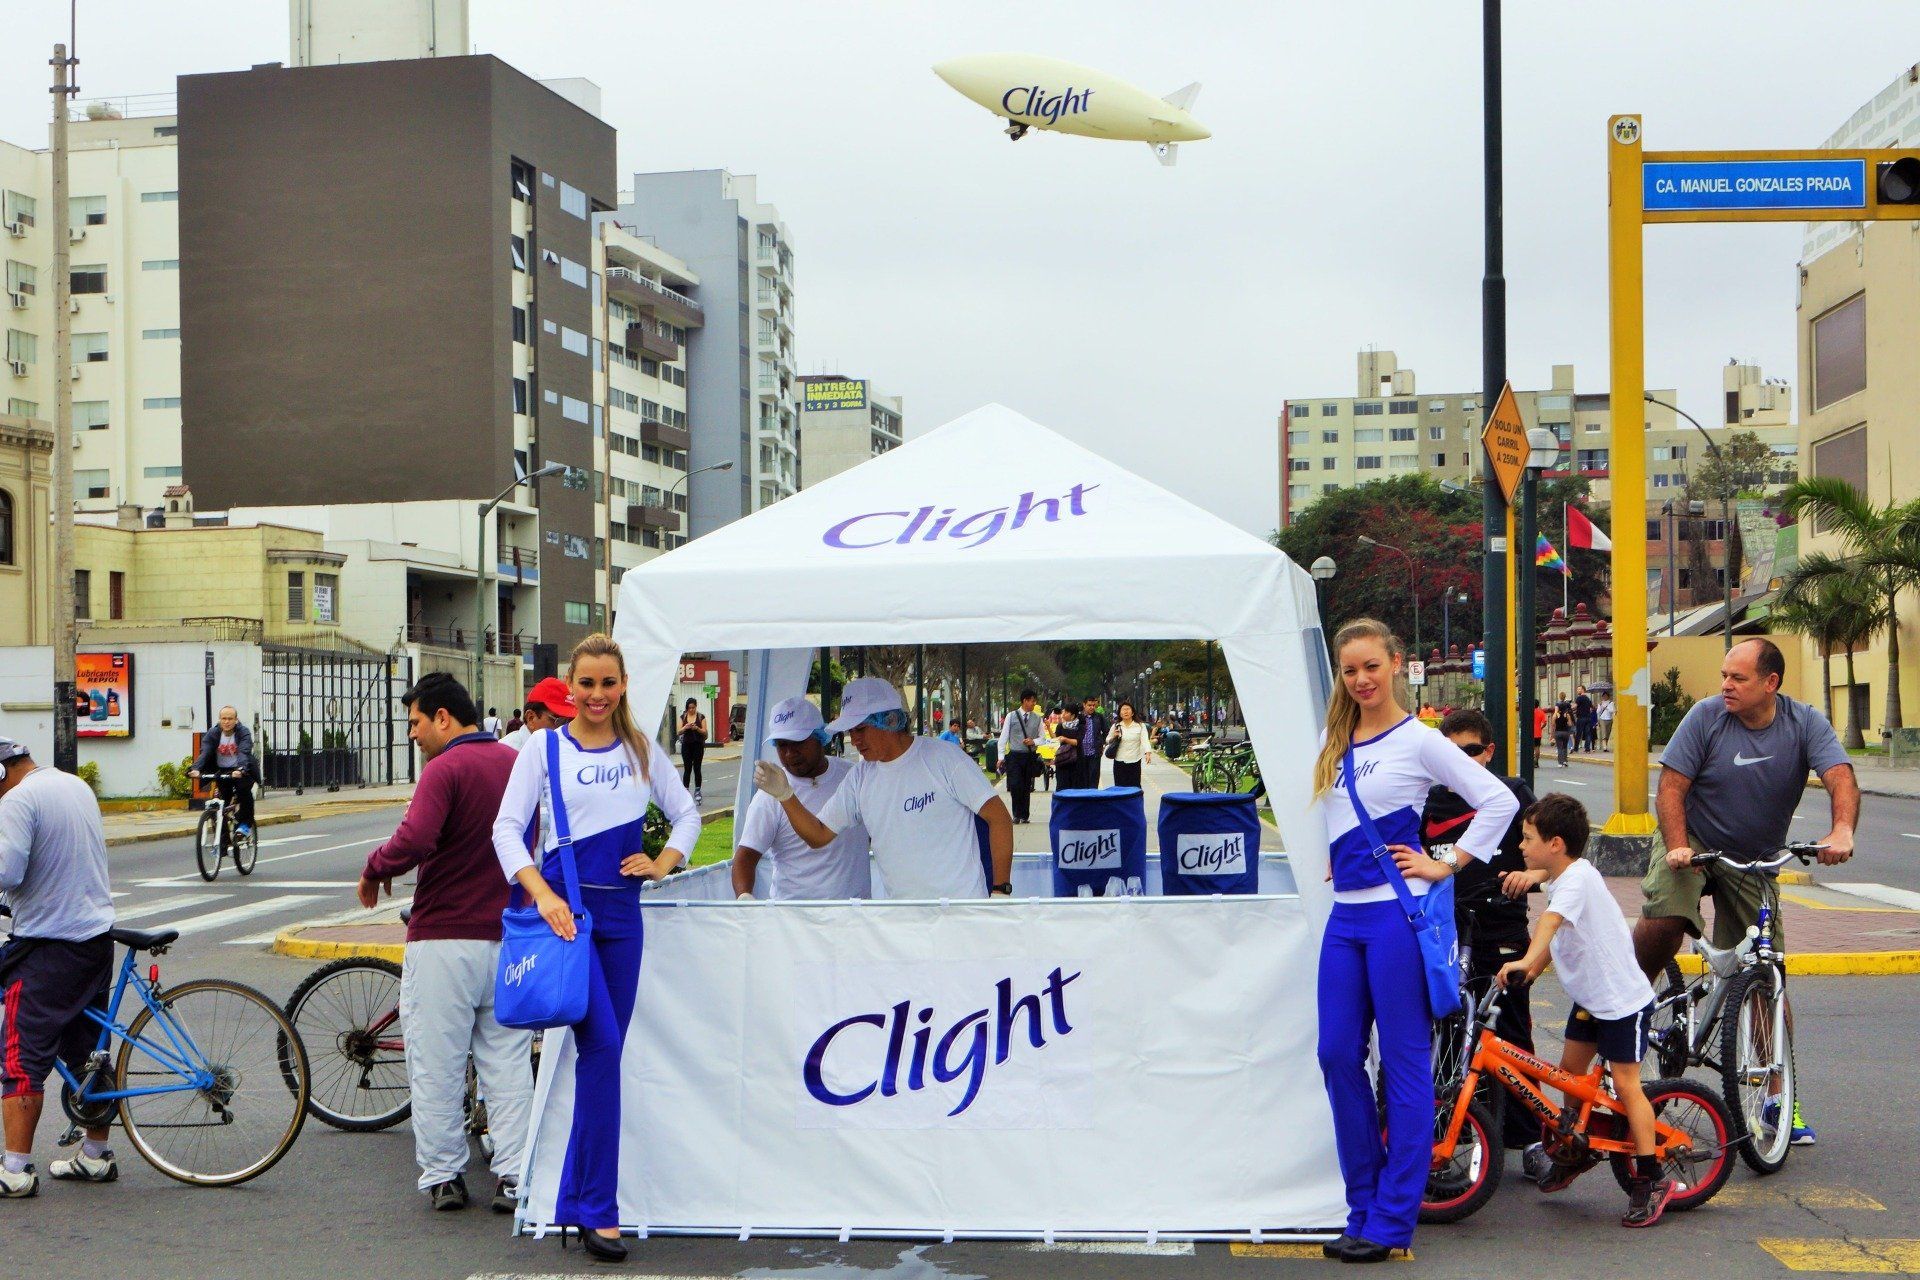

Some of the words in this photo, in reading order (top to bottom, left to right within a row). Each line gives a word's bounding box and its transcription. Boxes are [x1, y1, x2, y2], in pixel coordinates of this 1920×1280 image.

[1002, 86, 1096, 126] Clight
[1656, 179, 1677, 193] CA.
[1681, 179, 1733, 193] MANUEL
[1735, 178, 1803, 193] GONZALES
[1806, 177, 1851, 191] PRADA
[806, 382, 863, 392] ENTREGA
[807, 390, 863, 401] INMEDIATA
[1494, 419, 1511, 432] SOLO
[1496, 452, 1501, 462] A
[822, 483, 1100, 550] Clight
[77, 670, 119, 678] Lubricantes
[774, 711, 795, 724] Clight
[577, 762, 632, 790] Cligh
[904, 791, 936, 813] Clight
[1061, 832, 1118, 867] Clight
[1180, 835, 1242, 872] Clight
[505, 953, 540, 987] Clight
[803, 967, 1081, 1117] Clight
[1499, 1066, 1557, 1120] SCHWINN
